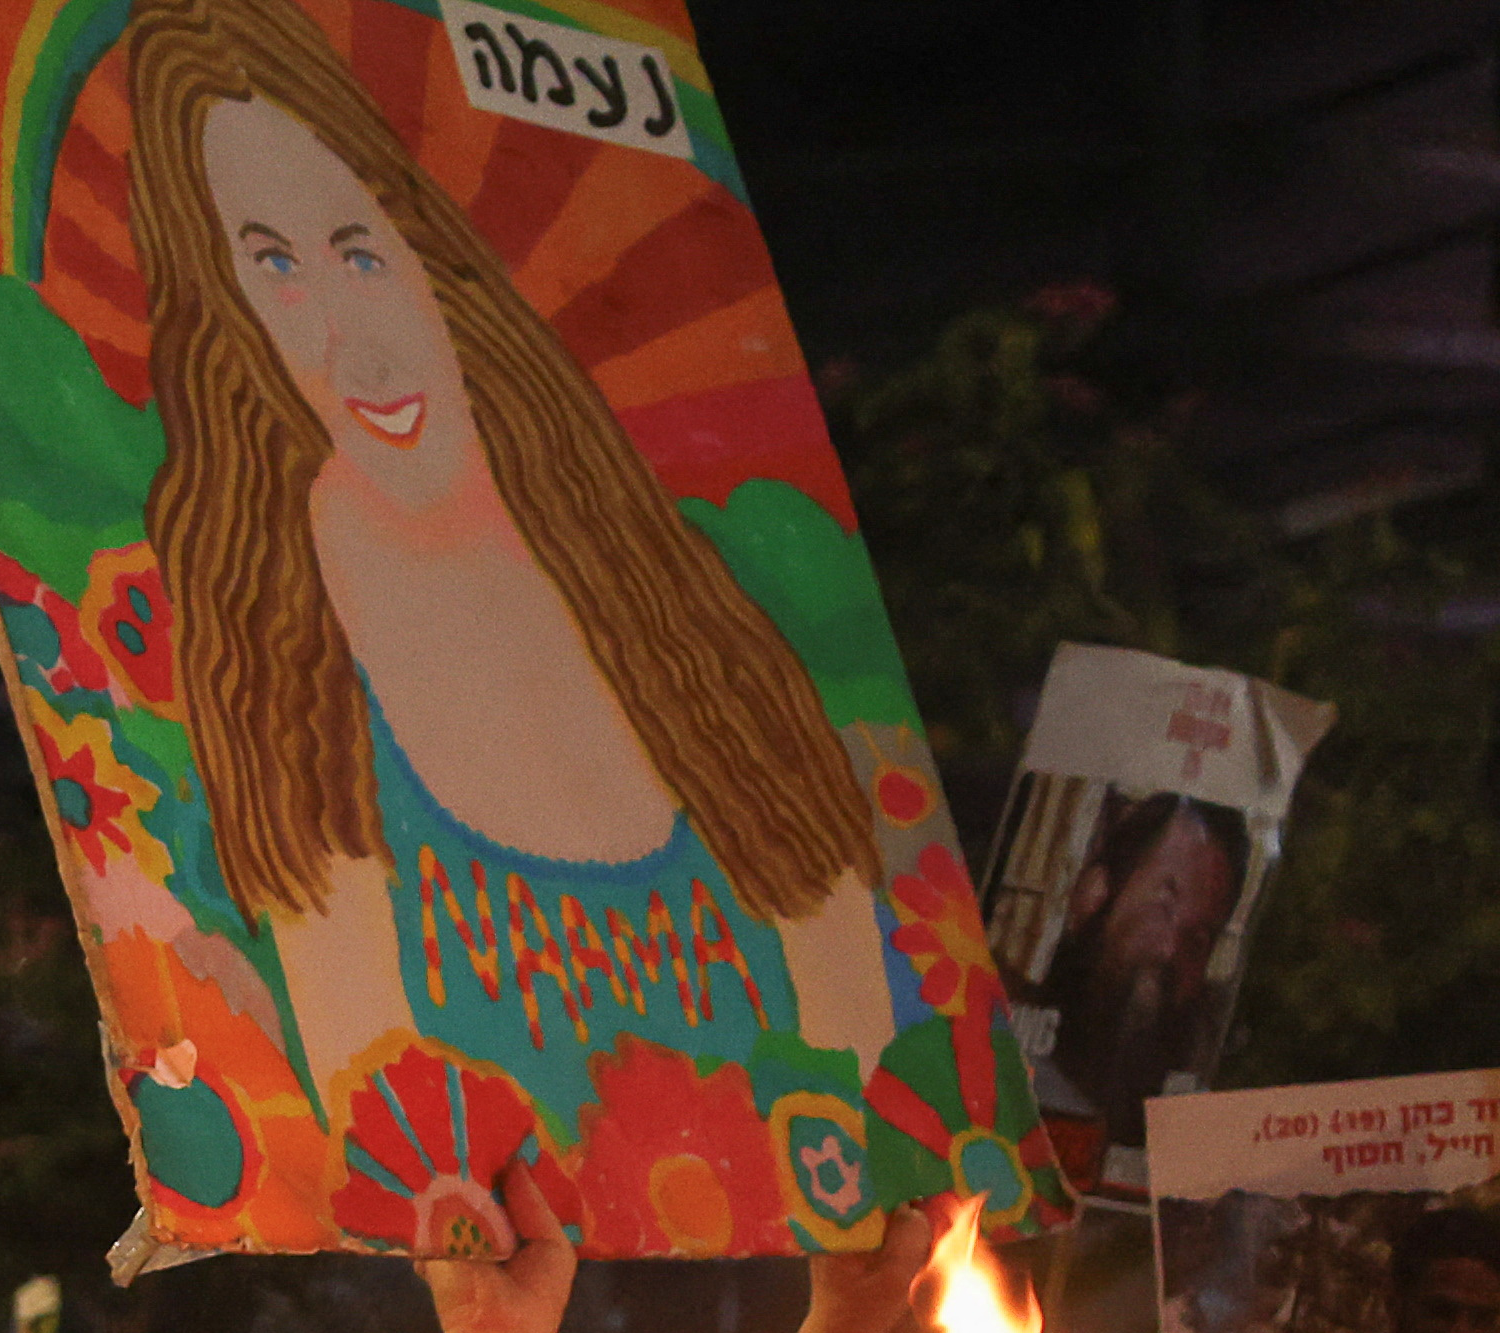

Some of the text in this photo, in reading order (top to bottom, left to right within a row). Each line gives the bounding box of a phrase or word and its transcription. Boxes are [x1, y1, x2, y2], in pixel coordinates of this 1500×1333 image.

[465, 22, 678, 137] נעמה
[418, 845, 770, 1050] NAAMA
[1399, 1101, 1454, 1135] כהן
[1322, 1140, 1404, 1174] חטוף
